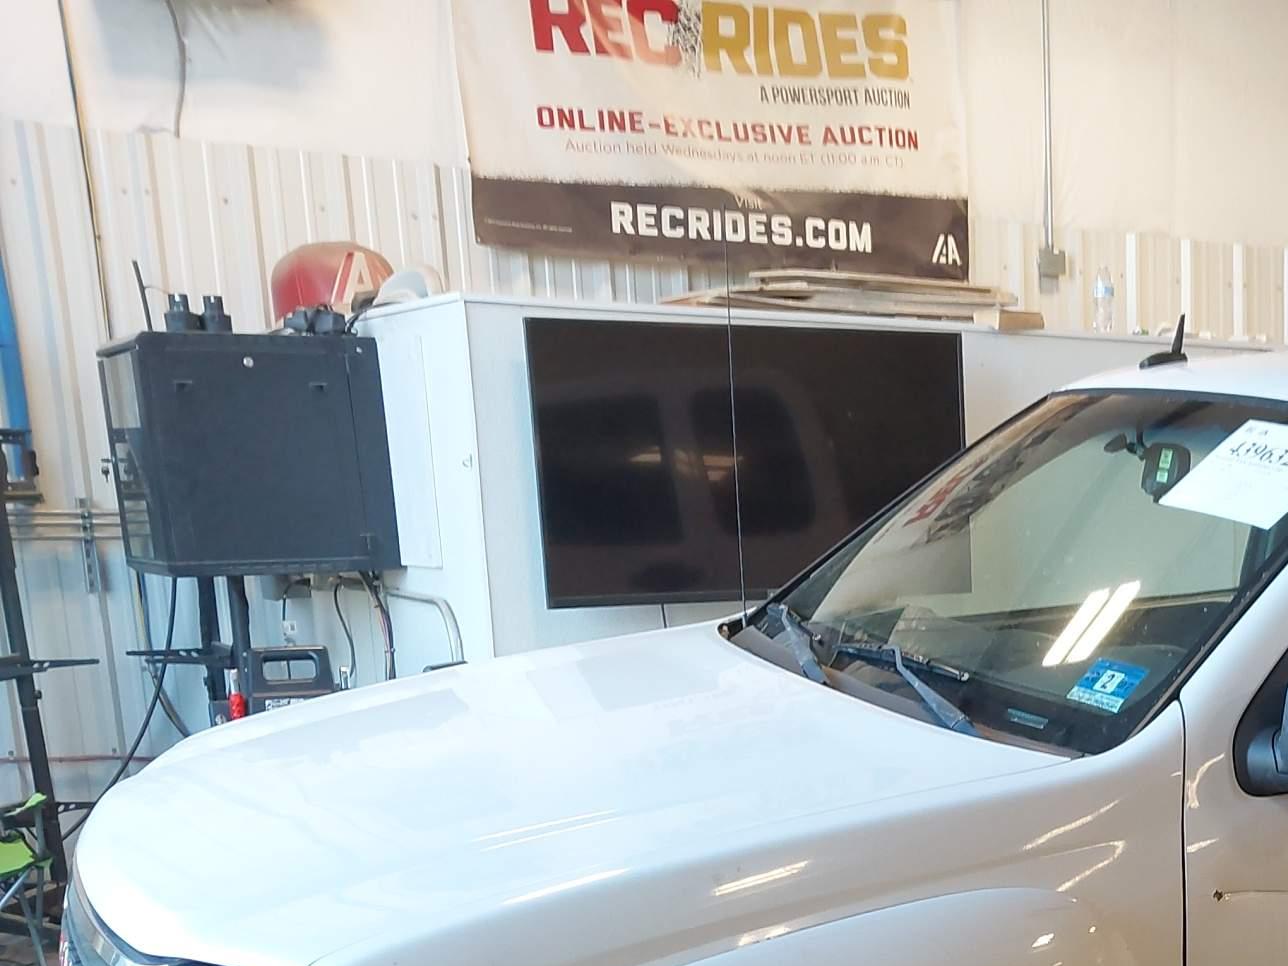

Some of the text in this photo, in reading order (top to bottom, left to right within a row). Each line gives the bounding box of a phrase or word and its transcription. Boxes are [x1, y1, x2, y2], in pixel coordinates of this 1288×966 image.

[529, 0, 910, 80] REC RIDES
[760, 85, 910, 110] A POWERSPORT AUCTION
[536, 106, 919, 152] ONLINE-EXCLUSIVE AUCTION
[565, 138, 621, 155] Auction
[626, 141, 657, 156] held
[609, 201, 873, 254] RECRIDES.COM
